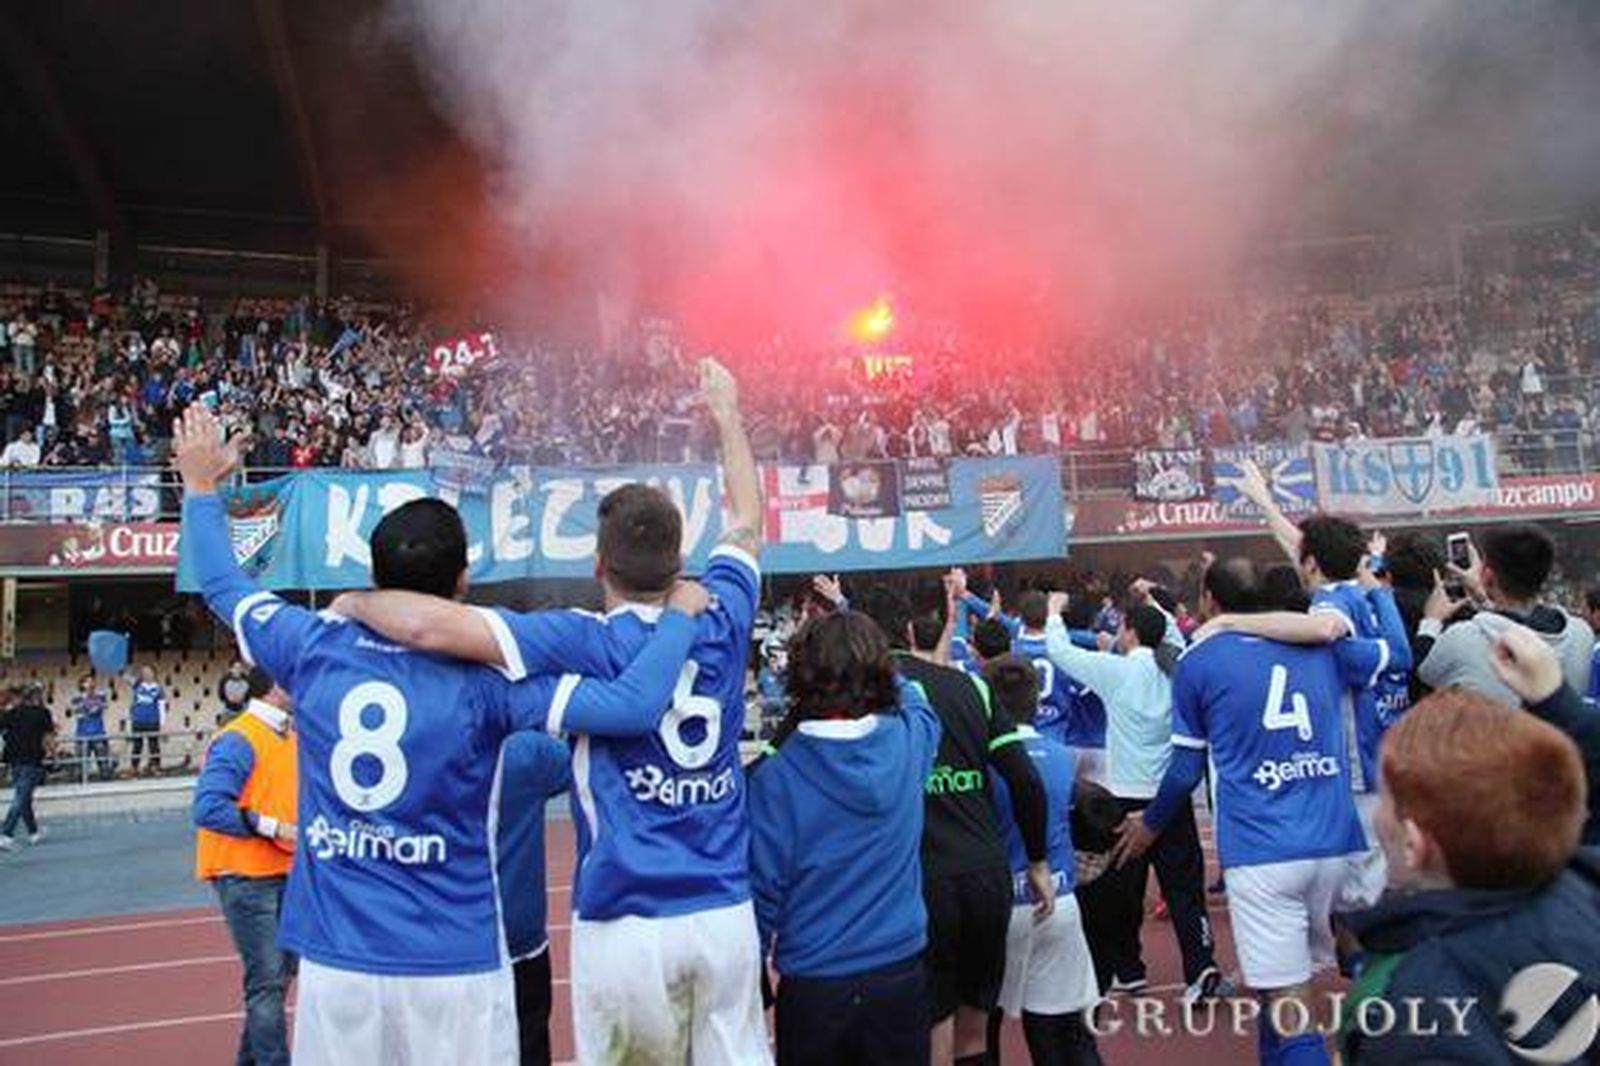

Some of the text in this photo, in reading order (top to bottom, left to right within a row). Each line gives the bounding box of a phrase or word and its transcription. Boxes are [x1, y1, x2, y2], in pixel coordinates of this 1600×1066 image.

[330, 680, 408, 812] 8
[659, 659, 721, 769] 6
[1262, 664, 1313, 741] 4
